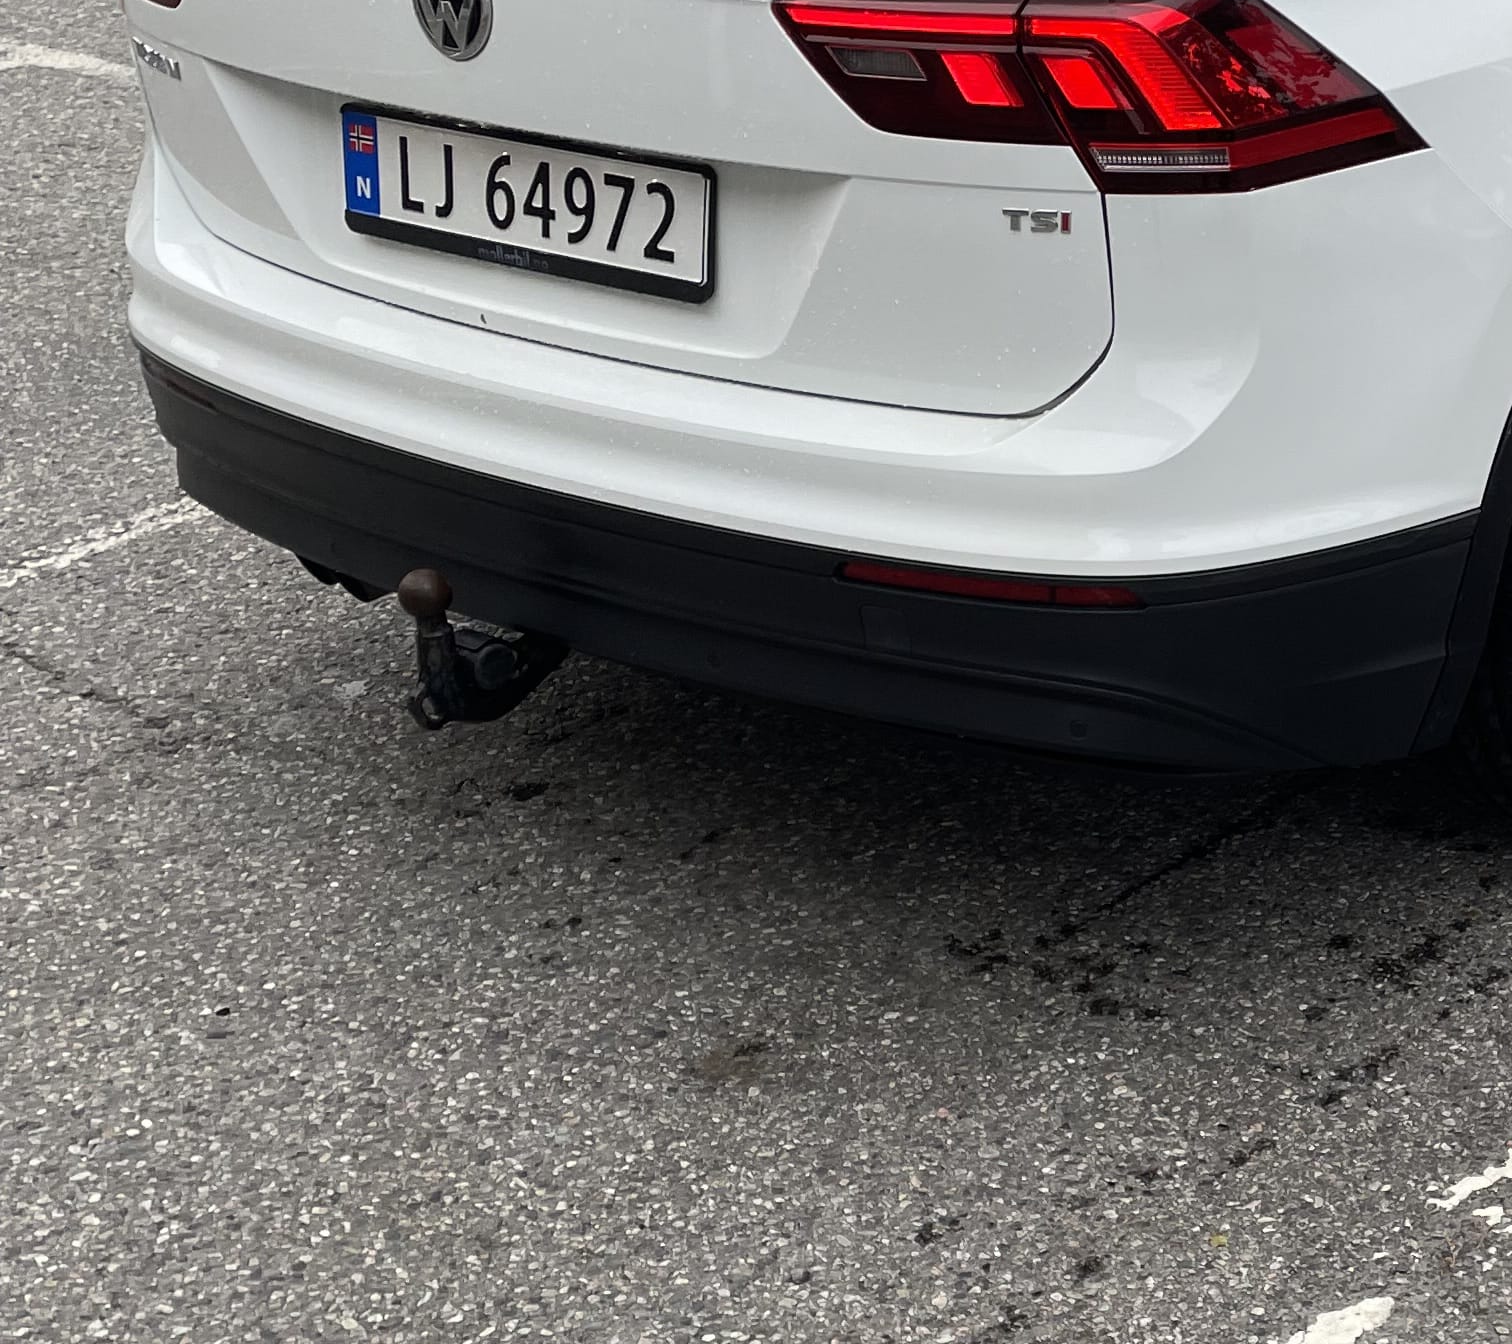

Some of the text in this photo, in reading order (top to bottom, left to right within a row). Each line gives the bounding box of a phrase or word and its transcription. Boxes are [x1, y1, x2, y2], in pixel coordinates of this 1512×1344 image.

[356, 175, 372, 200] N
[400, 135, 675, 263] LJ 64972
[1002, 207, 1071, 235] TSI
